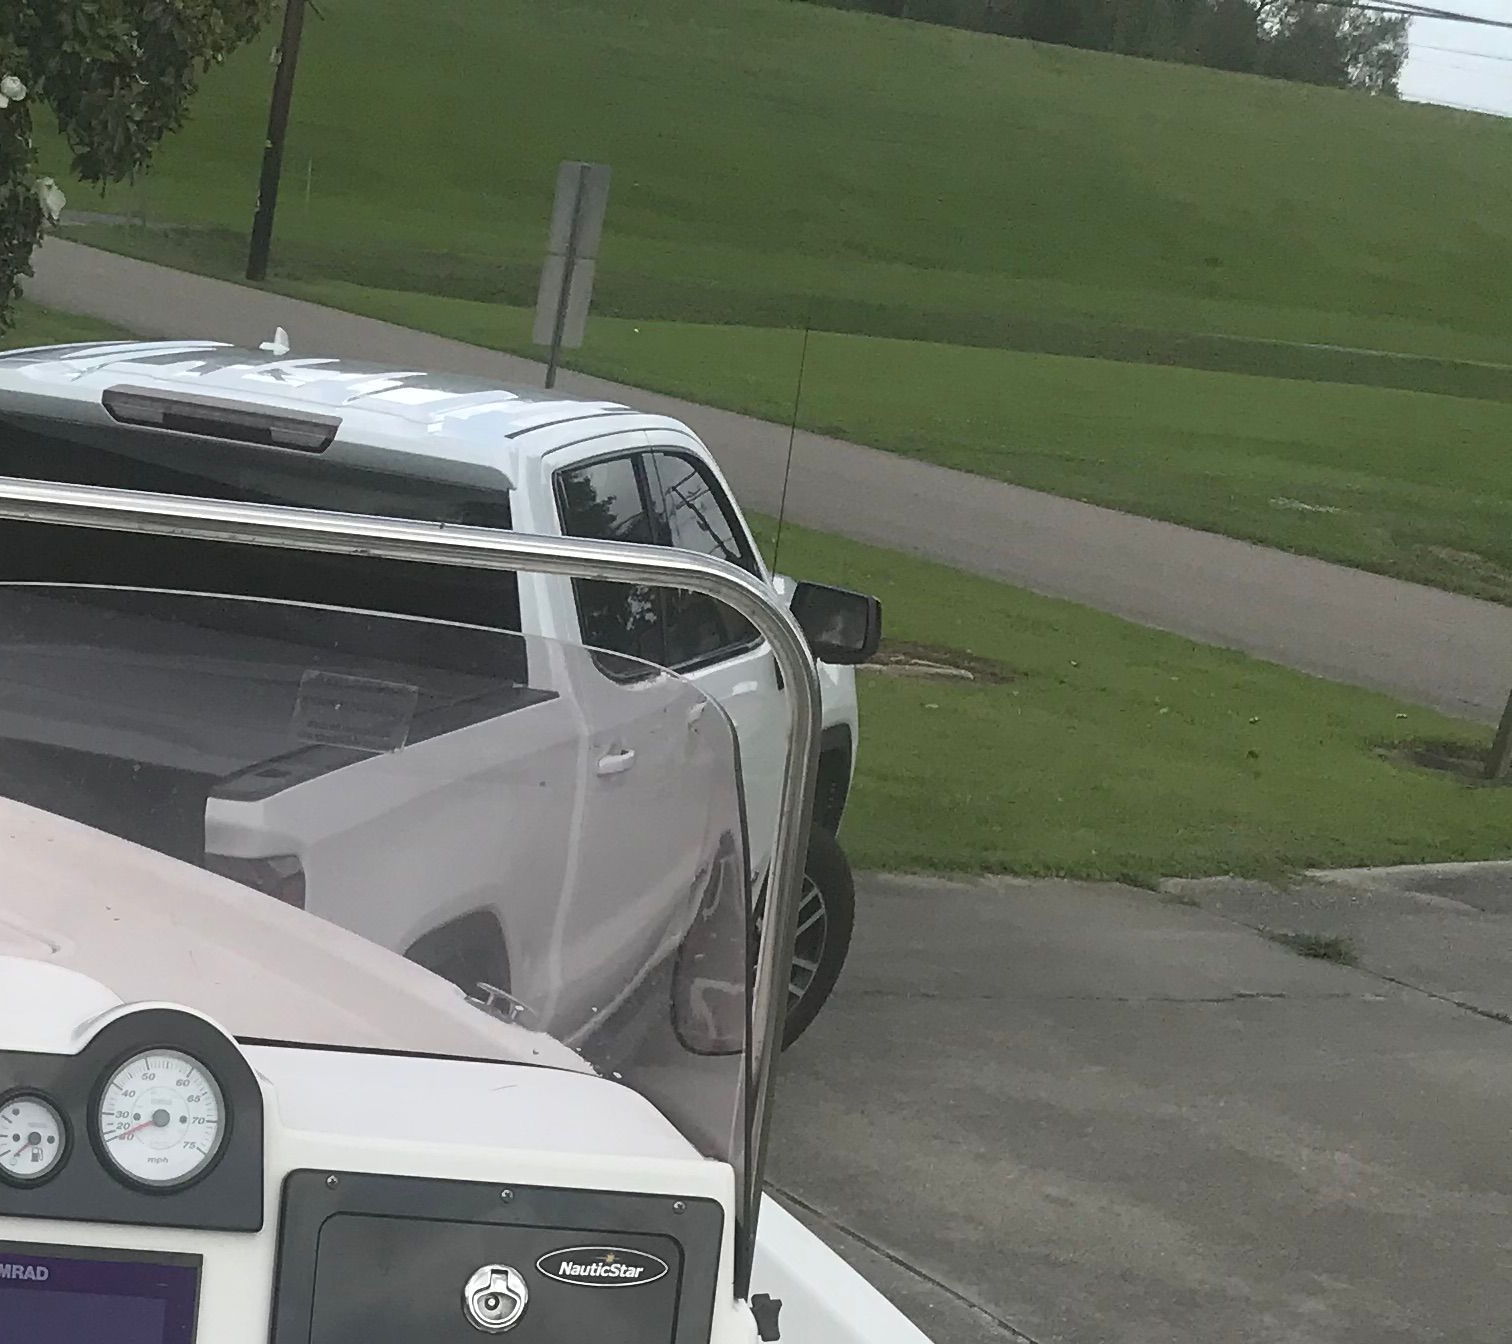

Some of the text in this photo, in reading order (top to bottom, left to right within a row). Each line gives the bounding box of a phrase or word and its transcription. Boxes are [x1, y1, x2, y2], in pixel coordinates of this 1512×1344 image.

[141, 1073, 156, 1081] 50
[176, 1079, 190, 1087] 60
[121, 1090, 136, 1098] 40
[187, 1095, 200, 1103] 65
[115, 1111, 129, 1119] 30
[191, 1117, 205, 1125] 70
[116, 1122, 130, 1130] 20
[183, 1141, 197, 1149] 75
[147, 1156, 169, 1165] mph
[558, 1261, 644, 1278] NauticStar
